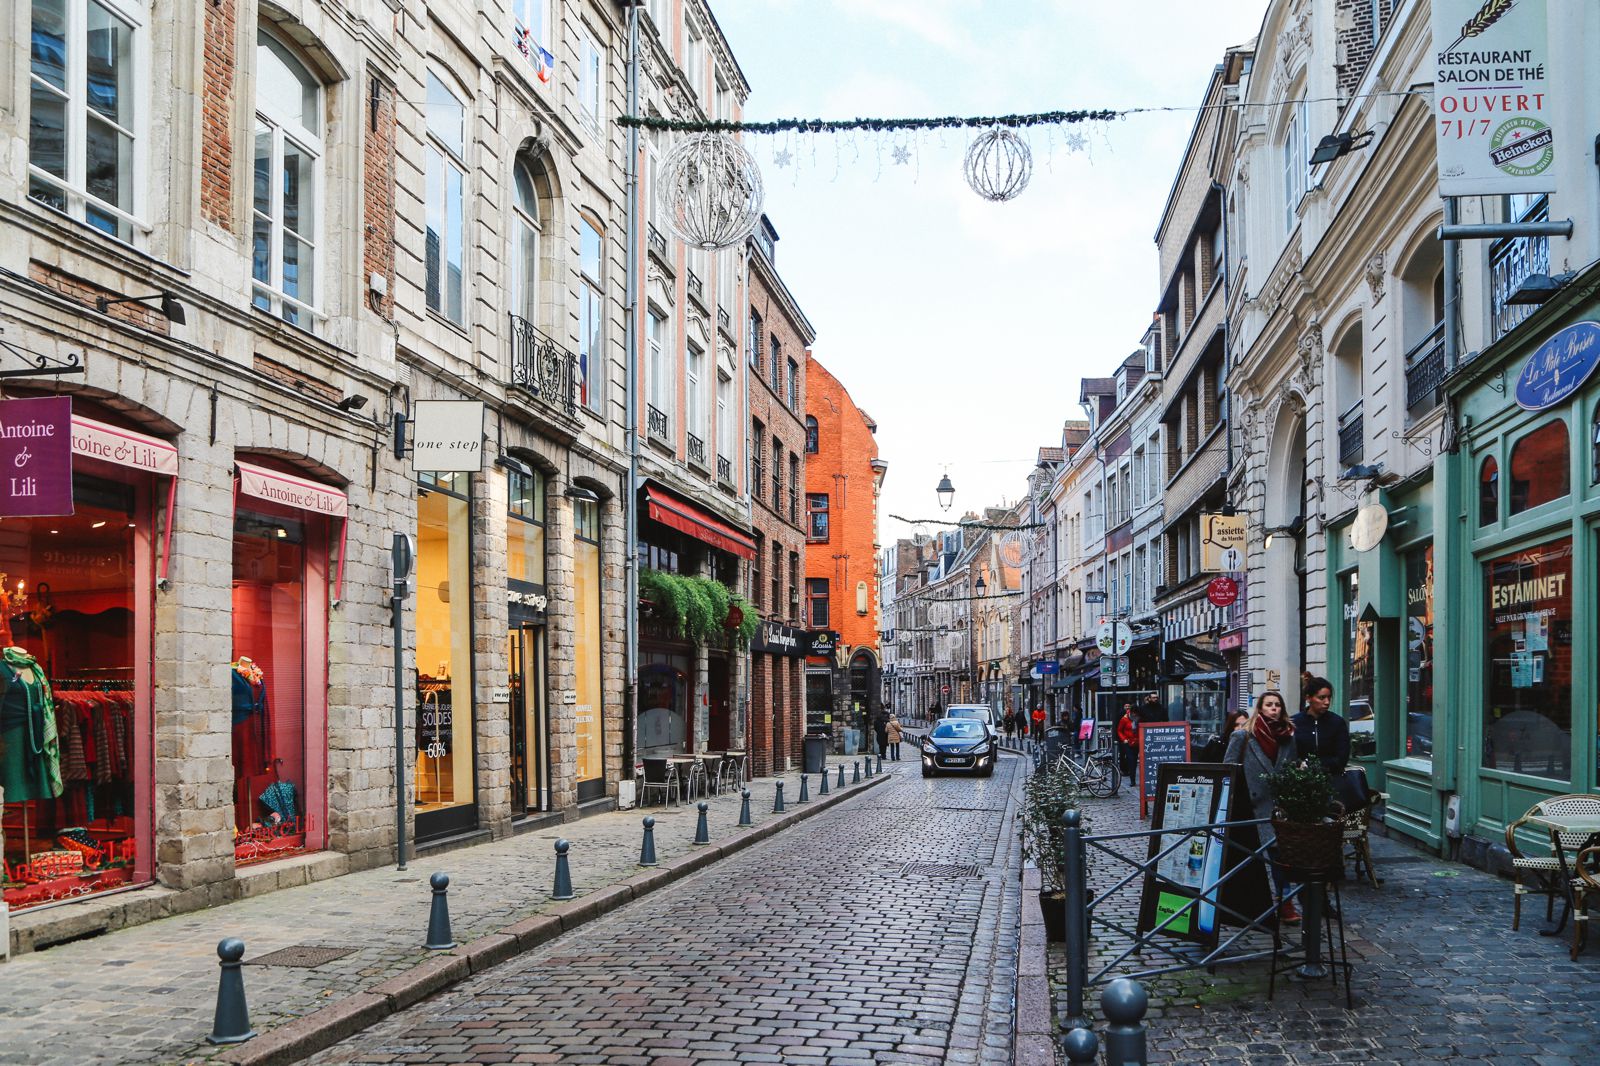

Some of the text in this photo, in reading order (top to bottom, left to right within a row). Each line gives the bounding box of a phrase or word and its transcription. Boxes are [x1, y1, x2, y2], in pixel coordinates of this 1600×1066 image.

[1438, 50, 1532, 65] RESTAURANT
[1438, 63, 1545, 83] SALON DE THÉ
[1440, 93, 1545, 114] OUVERT
[1495, 131, 1552, 162] Heineken
[1507, 166, 1536, 175] PREMIUM
[72, 435, 157, 469] toine & Lili
[417, 440, 479, 452] one step
[15, 446, 32, 467] &
[10, 477, 37, 497] Lili
[260, 480, 333, 512] Antoine & Lili
[1492, 573, 1566, 609] ESTAMINET
[423, 711, 452, 726] SOLDES
